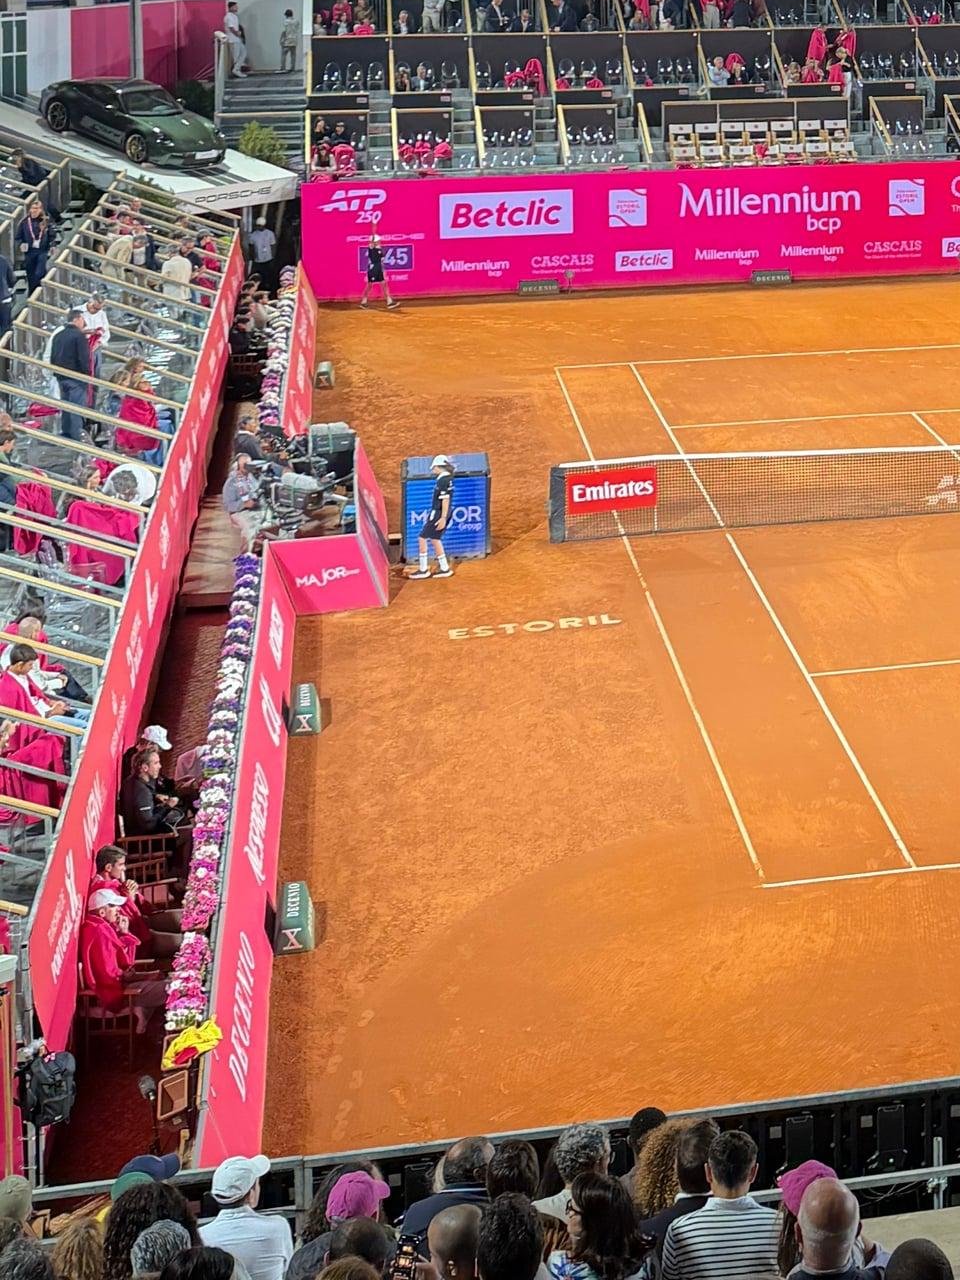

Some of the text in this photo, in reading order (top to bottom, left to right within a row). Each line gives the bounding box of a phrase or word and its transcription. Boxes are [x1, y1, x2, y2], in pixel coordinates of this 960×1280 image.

[195, 186, 272, 205] PORSCHE
[316, 188, 387, 213] ATP
[677, 182, 861, 218] Millennium
[355, 210, 382, 224] 250
[450, 198, 562, 229] Betclic
[806, 215, 841, 234] bcp
[695, 248, 759, 261] Millennium
[780, 244, 844, 257] Millennium
[864, 240, 922, 253] CASCAIS
[441, 259, 510, 273] Millennium
[531, 254, 594, 268] CASCAIS
[620, 253, 668, 267] Betclic
[572, 479, 654, 503] Emirates
[458, 522, 482, 531] Group
[295, 566, 346, 588] MAJOR
[448, 613, 622, 640] ESTORIL
[286, 882, 300, 918] DECENIO
[229, 930, 255, 1103] DECENIO
